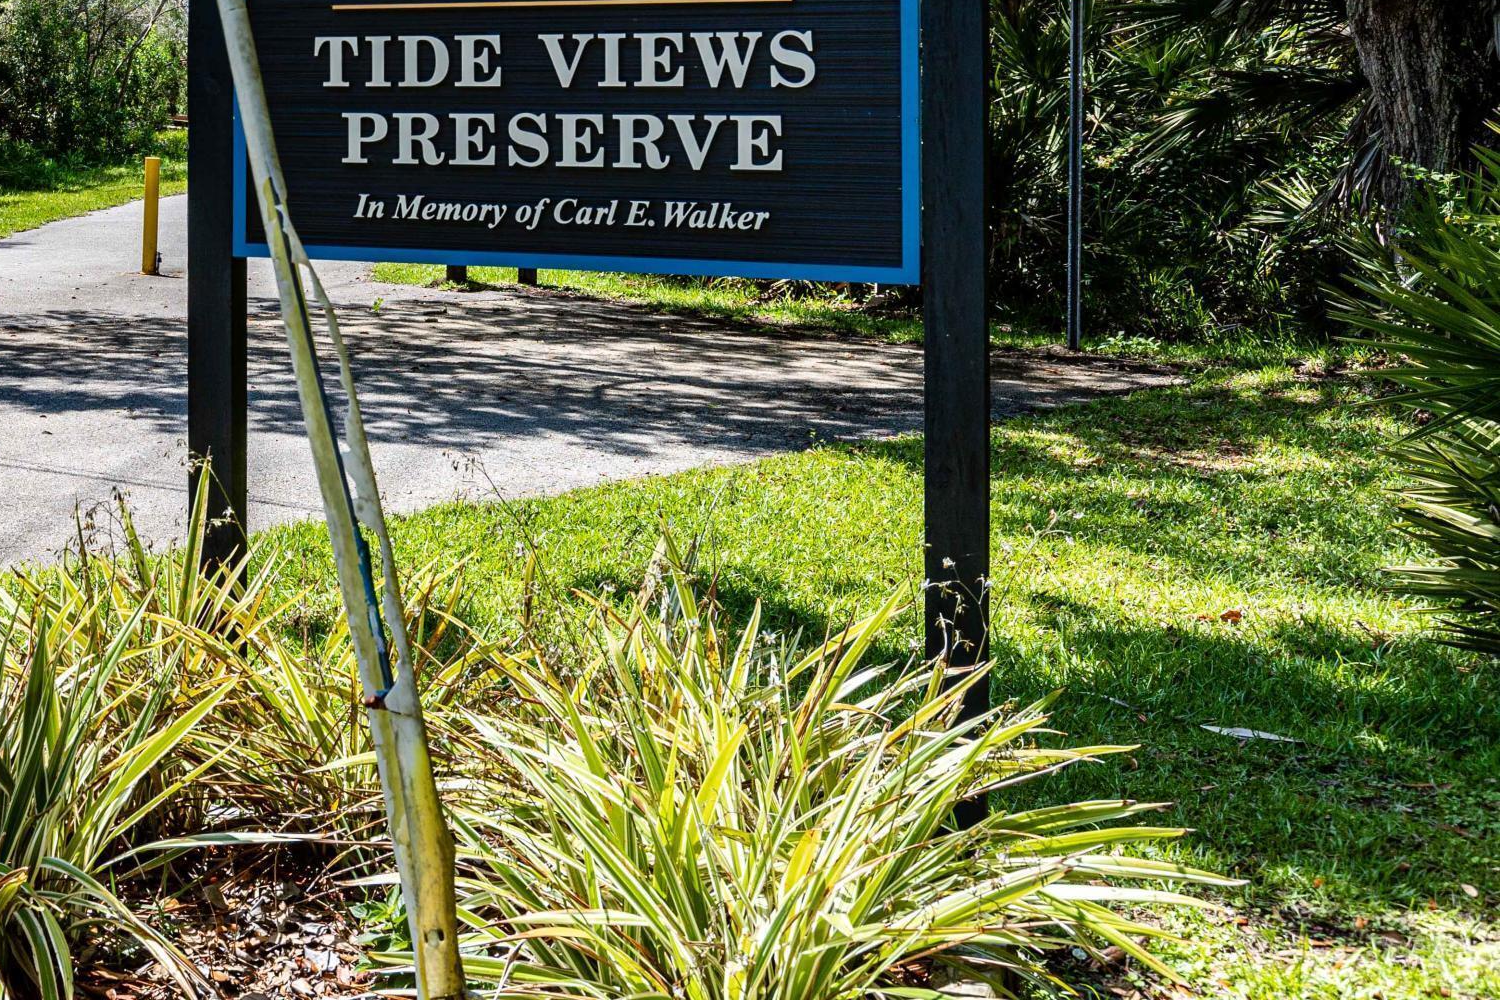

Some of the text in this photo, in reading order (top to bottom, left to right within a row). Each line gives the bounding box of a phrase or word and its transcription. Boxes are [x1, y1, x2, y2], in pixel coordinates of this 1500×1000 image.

[314, 29, 816, 89] TIDE VIEWS
[341, 112, 784, 171] PRESERVE
[354, 193, 385, 219] In
[393, 195, 507, 229] Memory
[514, 198, 550, 229] of
[553, 199, 618, 226] Carl
[663, 202, 770, 230] Walker
